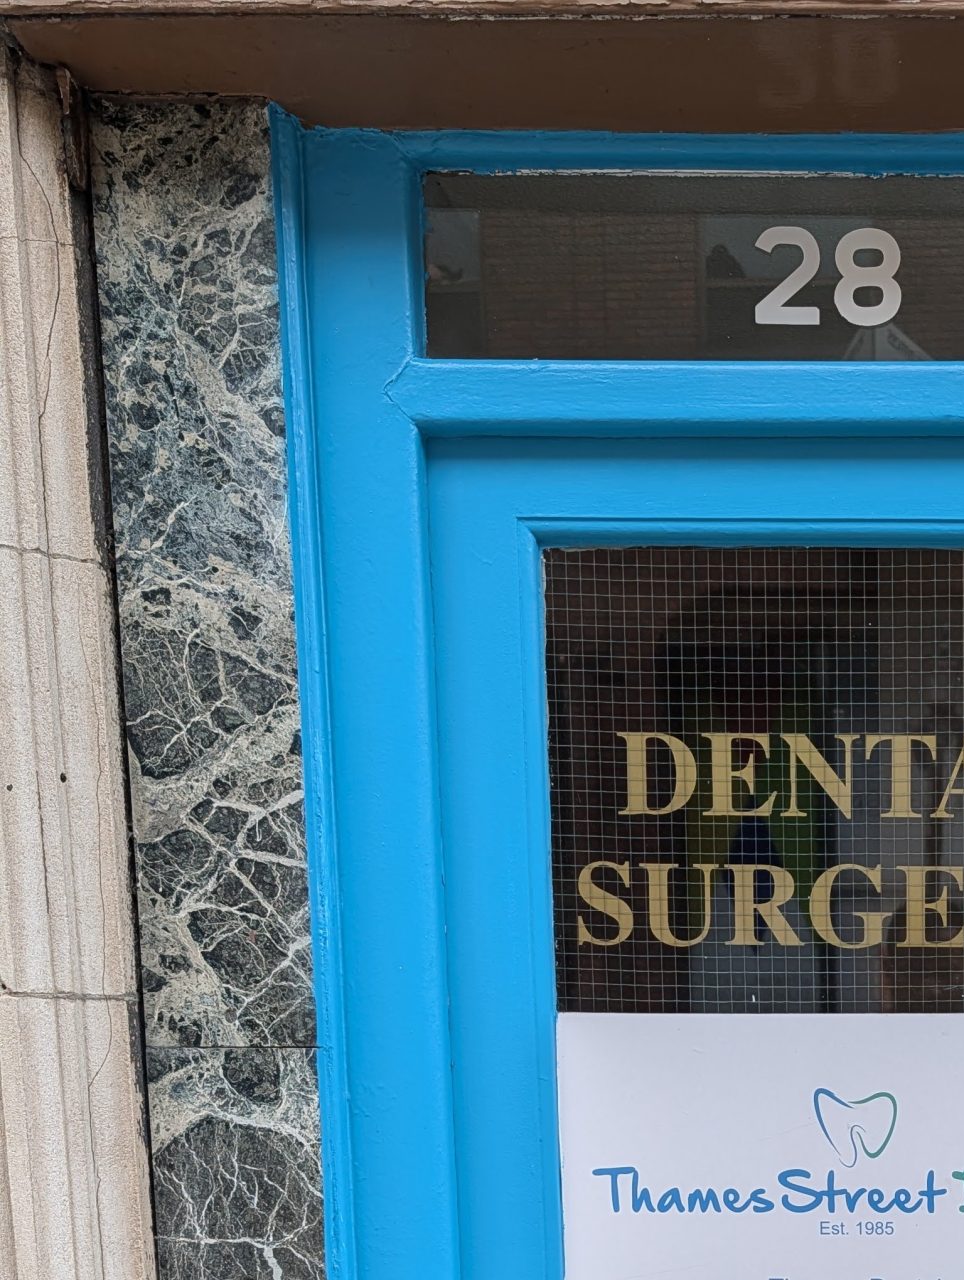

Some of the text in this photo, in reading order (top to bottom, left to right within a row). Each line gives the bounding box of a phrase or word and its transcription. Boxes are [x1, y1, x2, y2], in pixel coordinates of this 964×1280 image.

[754, 226, 902, 326] 28
[592, 1166, 775, 1213] Thames
[777, 1168, 947, 1214] Street
[819, 1220, 895, 1236] Est. 1985
